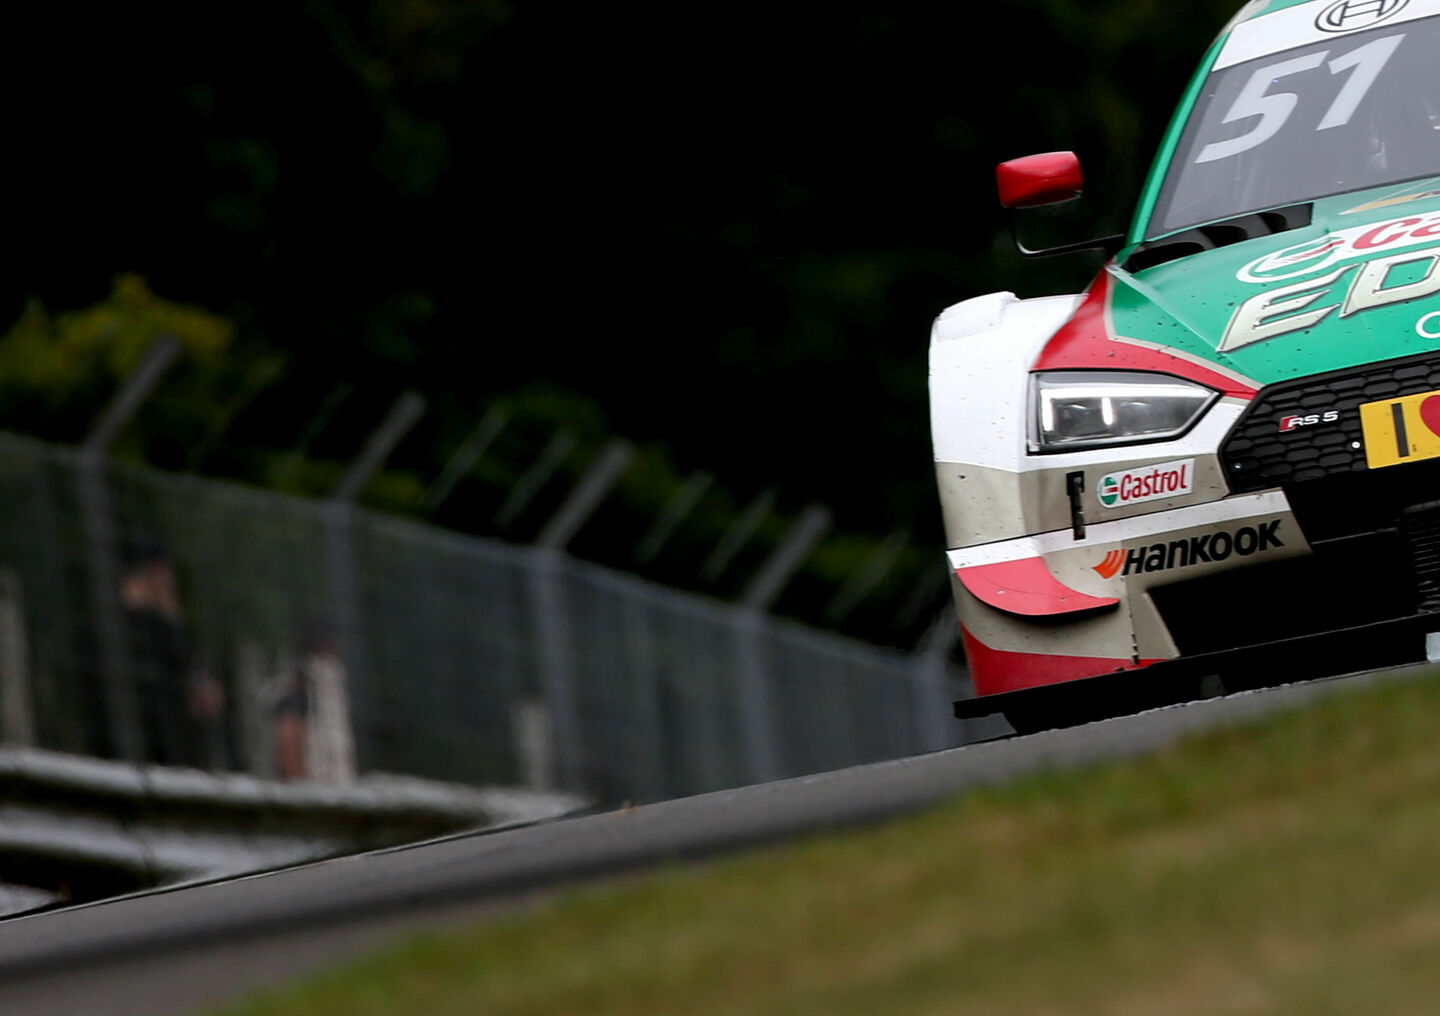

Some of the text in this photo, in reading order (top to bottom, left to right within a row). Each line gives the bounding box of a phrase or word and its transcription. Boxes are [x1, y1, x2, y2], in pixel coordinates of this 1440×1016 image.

[1195, 33, 1406, 165] 51
[1286, 410, 1339, 429] RS 5
[1391, 402, 1411, 458] I
[1120, 464, 1187, 501] Castrol
